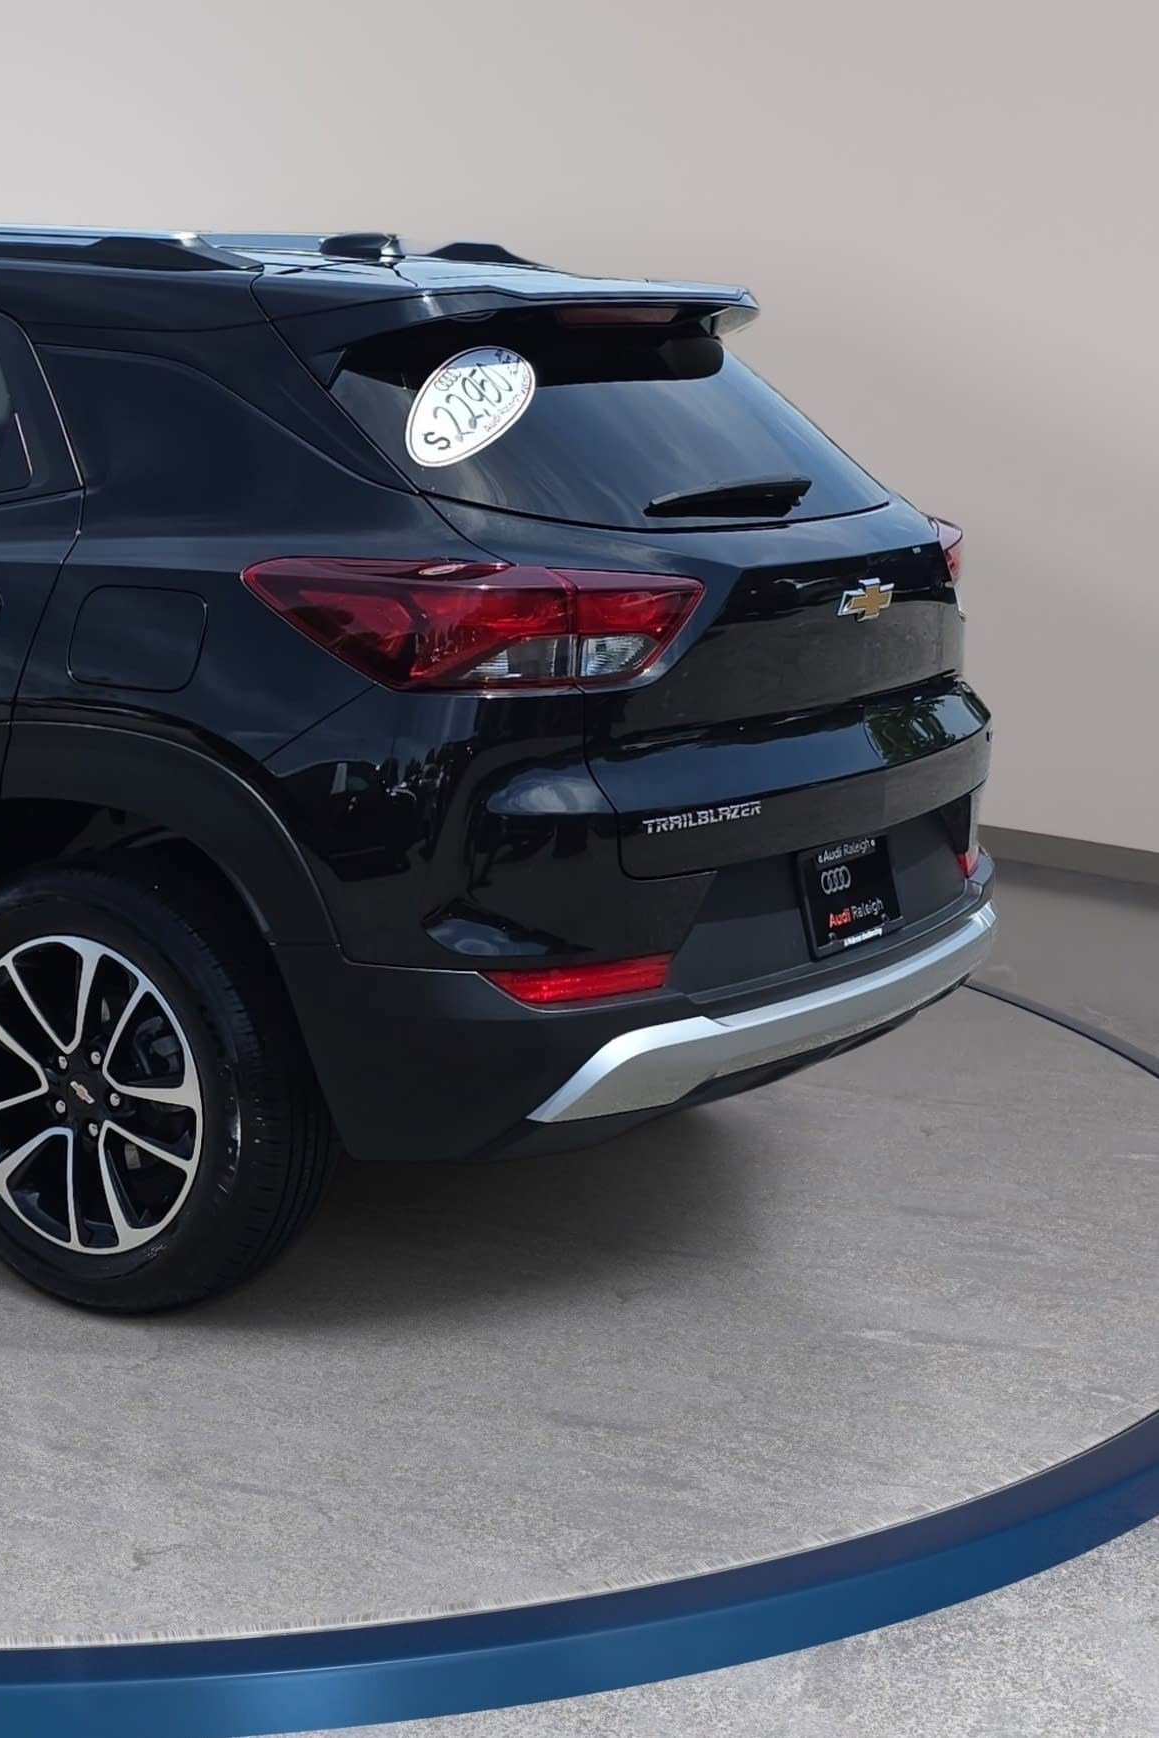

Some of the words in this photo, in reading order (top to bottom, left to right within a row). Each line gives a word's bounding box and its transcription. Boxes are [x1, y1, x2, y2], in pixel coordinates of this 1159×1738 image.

[642, 800, 762, 834] TRAILBLAZER
[823, 847, 843, 863] Audi
[843, 837, 871, 857] Raleigh
[829, 908, 852, 928] Audi
[851, 897, 884, 920] Raleigh
